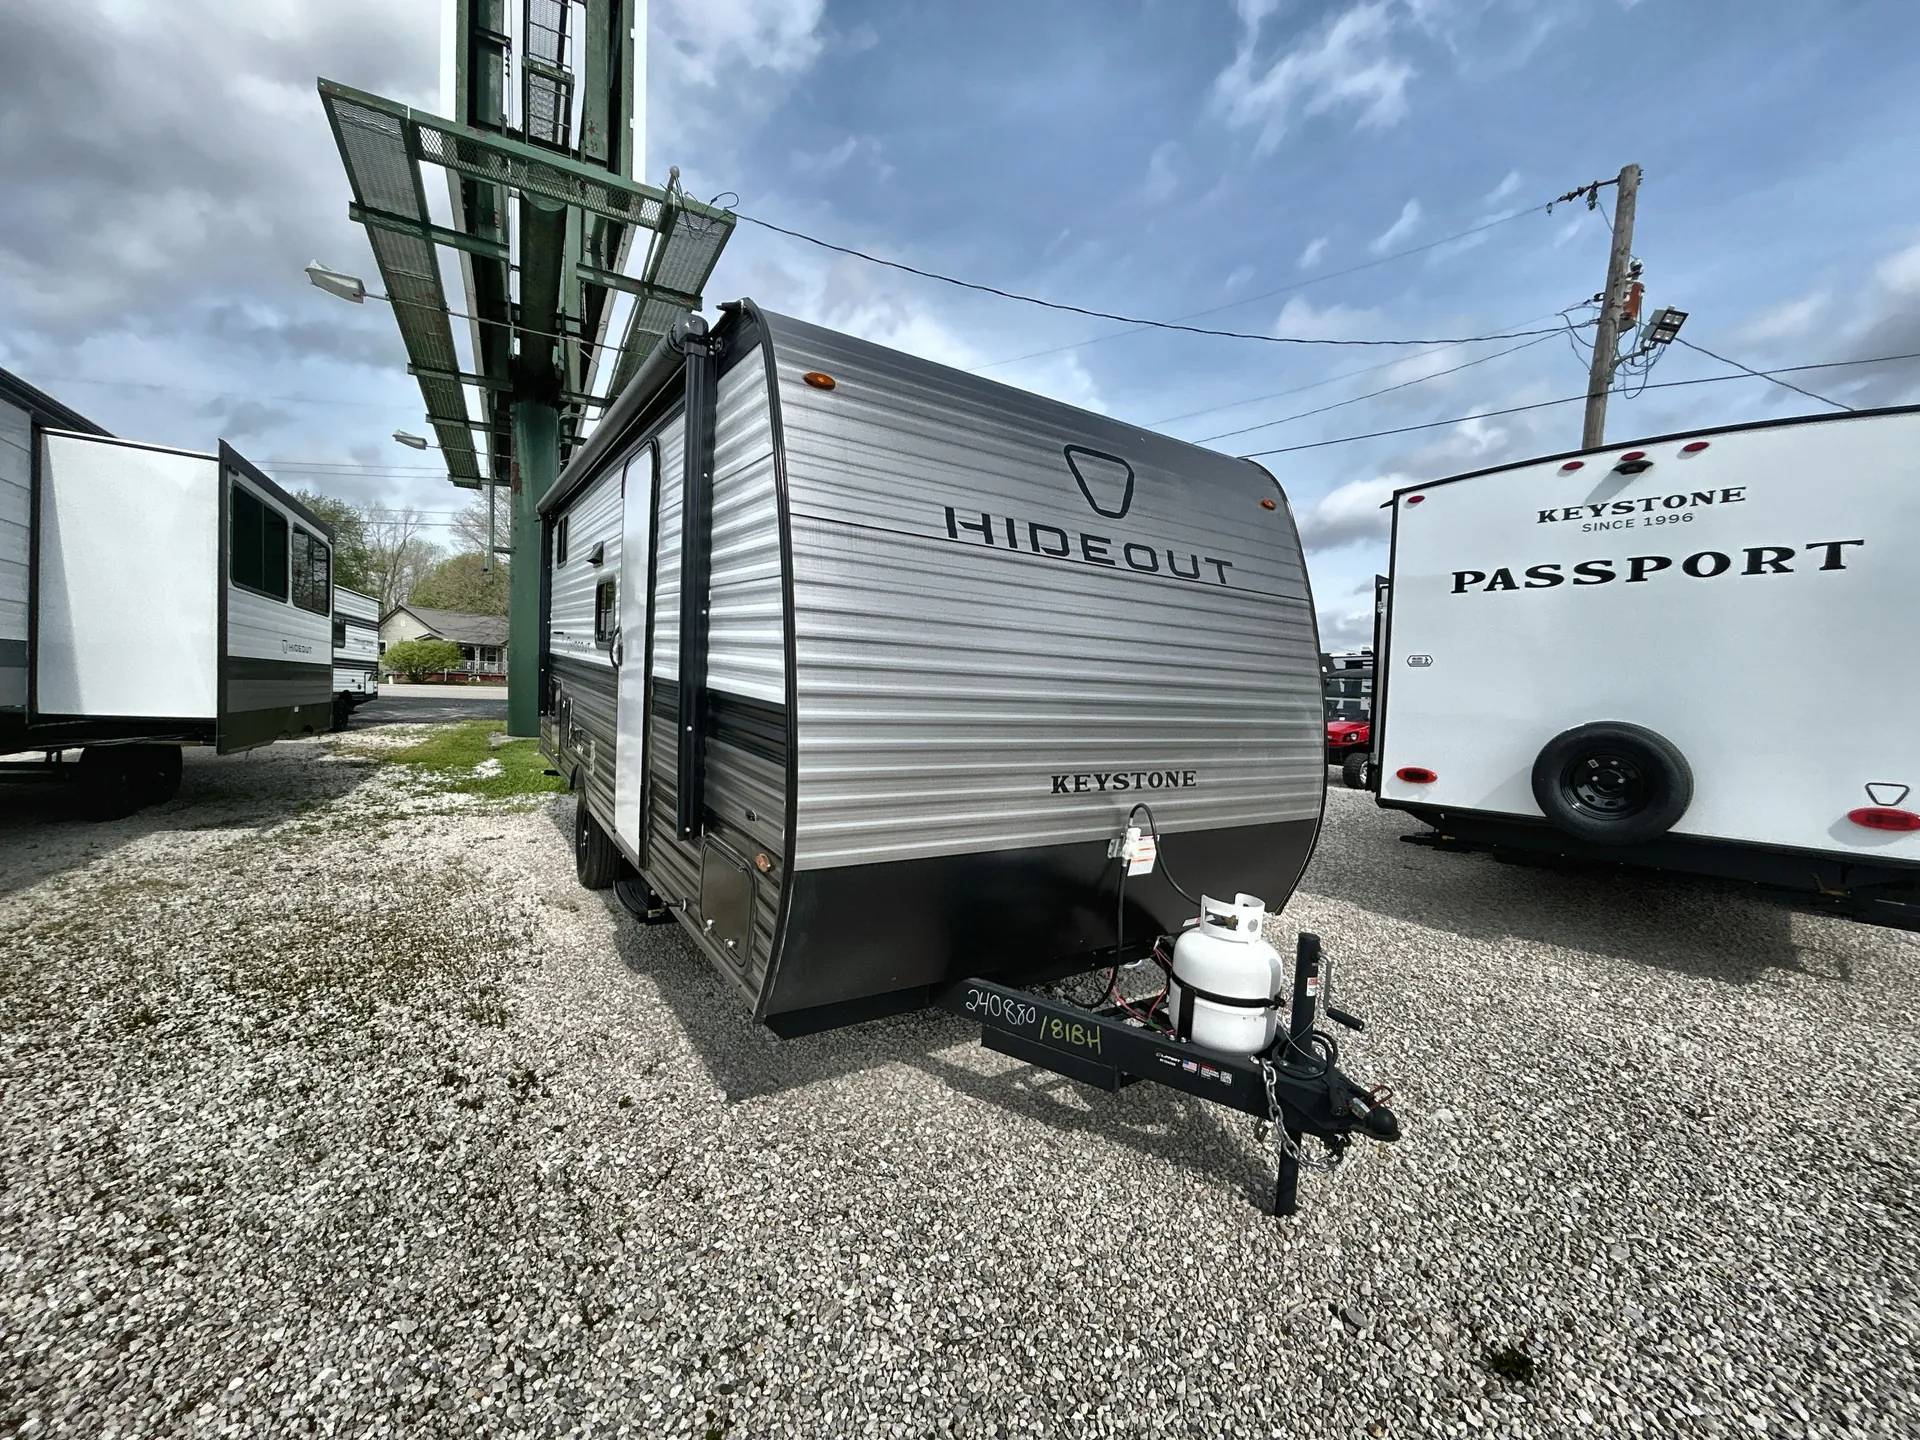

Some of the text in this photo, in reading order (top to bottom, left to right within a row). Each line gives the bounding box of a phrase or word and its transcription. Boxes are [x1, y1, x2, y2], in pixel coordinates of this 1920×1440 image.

[1536, 486, 1748, 524] KEYSTONE
[1581, 512, 1694, 533] SINCE 1996
[944, 506, 1233, 585] HIDEOUT
[1451, 539, 1865, 594] PASSPORT
[288, 643, 312, 654] HIDEOUT
[1051, 770, 1197, 794] KEYSTONE
[965, 989, 1036, 1025] 240880
